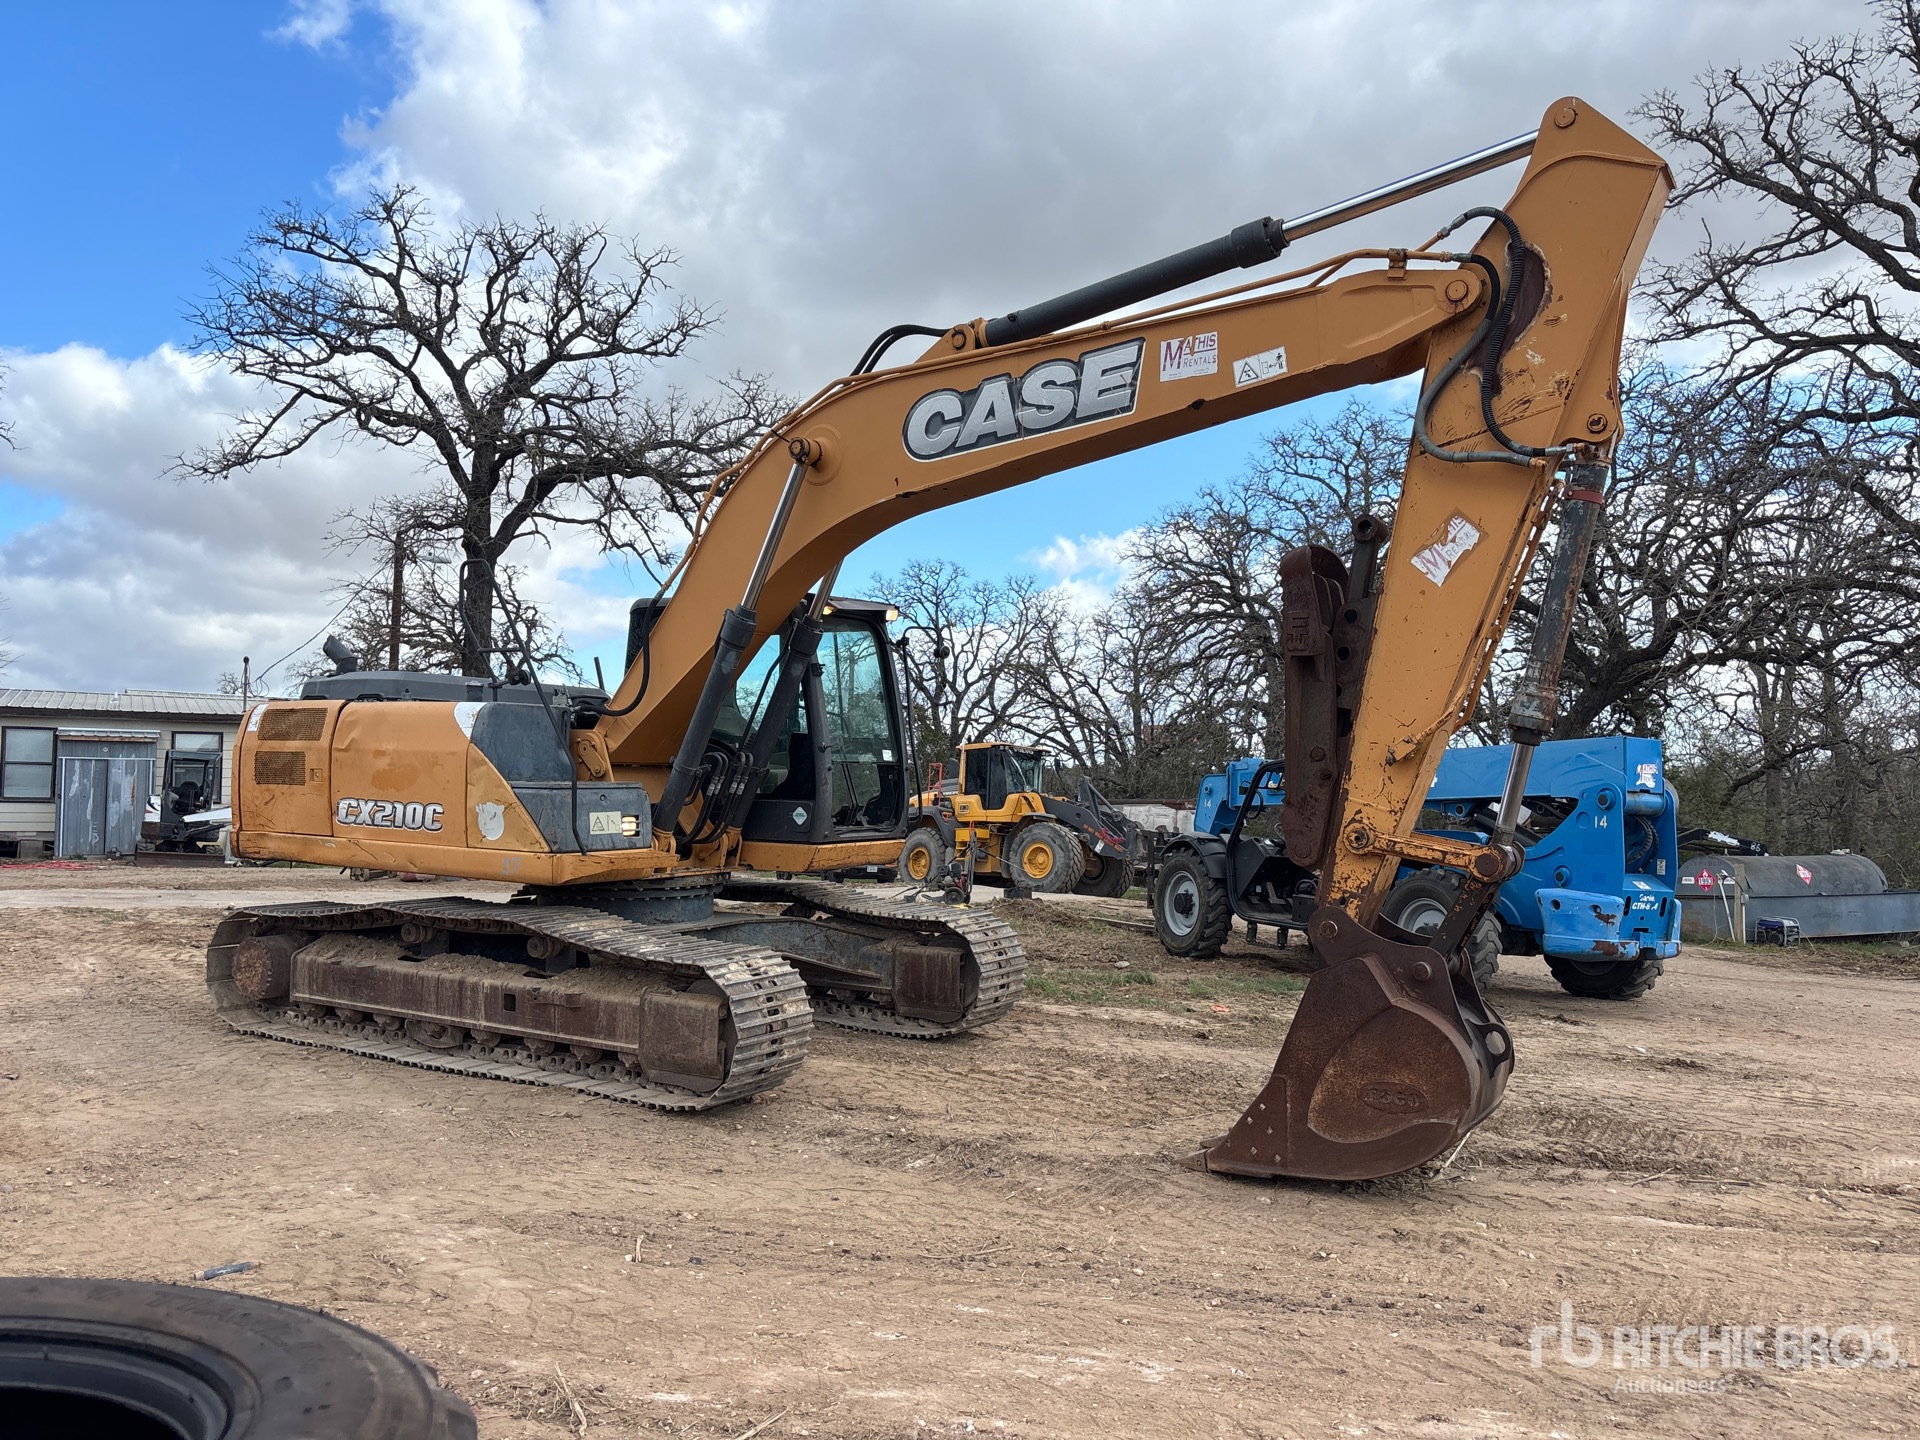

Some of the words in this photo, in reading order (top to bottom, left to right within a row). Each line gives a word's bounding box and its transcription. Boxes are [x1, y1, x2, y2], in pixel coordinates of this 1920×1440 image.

[1162, 334, 1216, 371] MAHIS
[1183, 355, 1216, 368] RENTALS
[903, 340, 1144, 459] CASE
[1204, 798, 1212, 808] 14
[337, 798, 444, 831] CX210C
[1594, 815, 1607, 829] 14
[1750, 841, 1761, 852] 86
